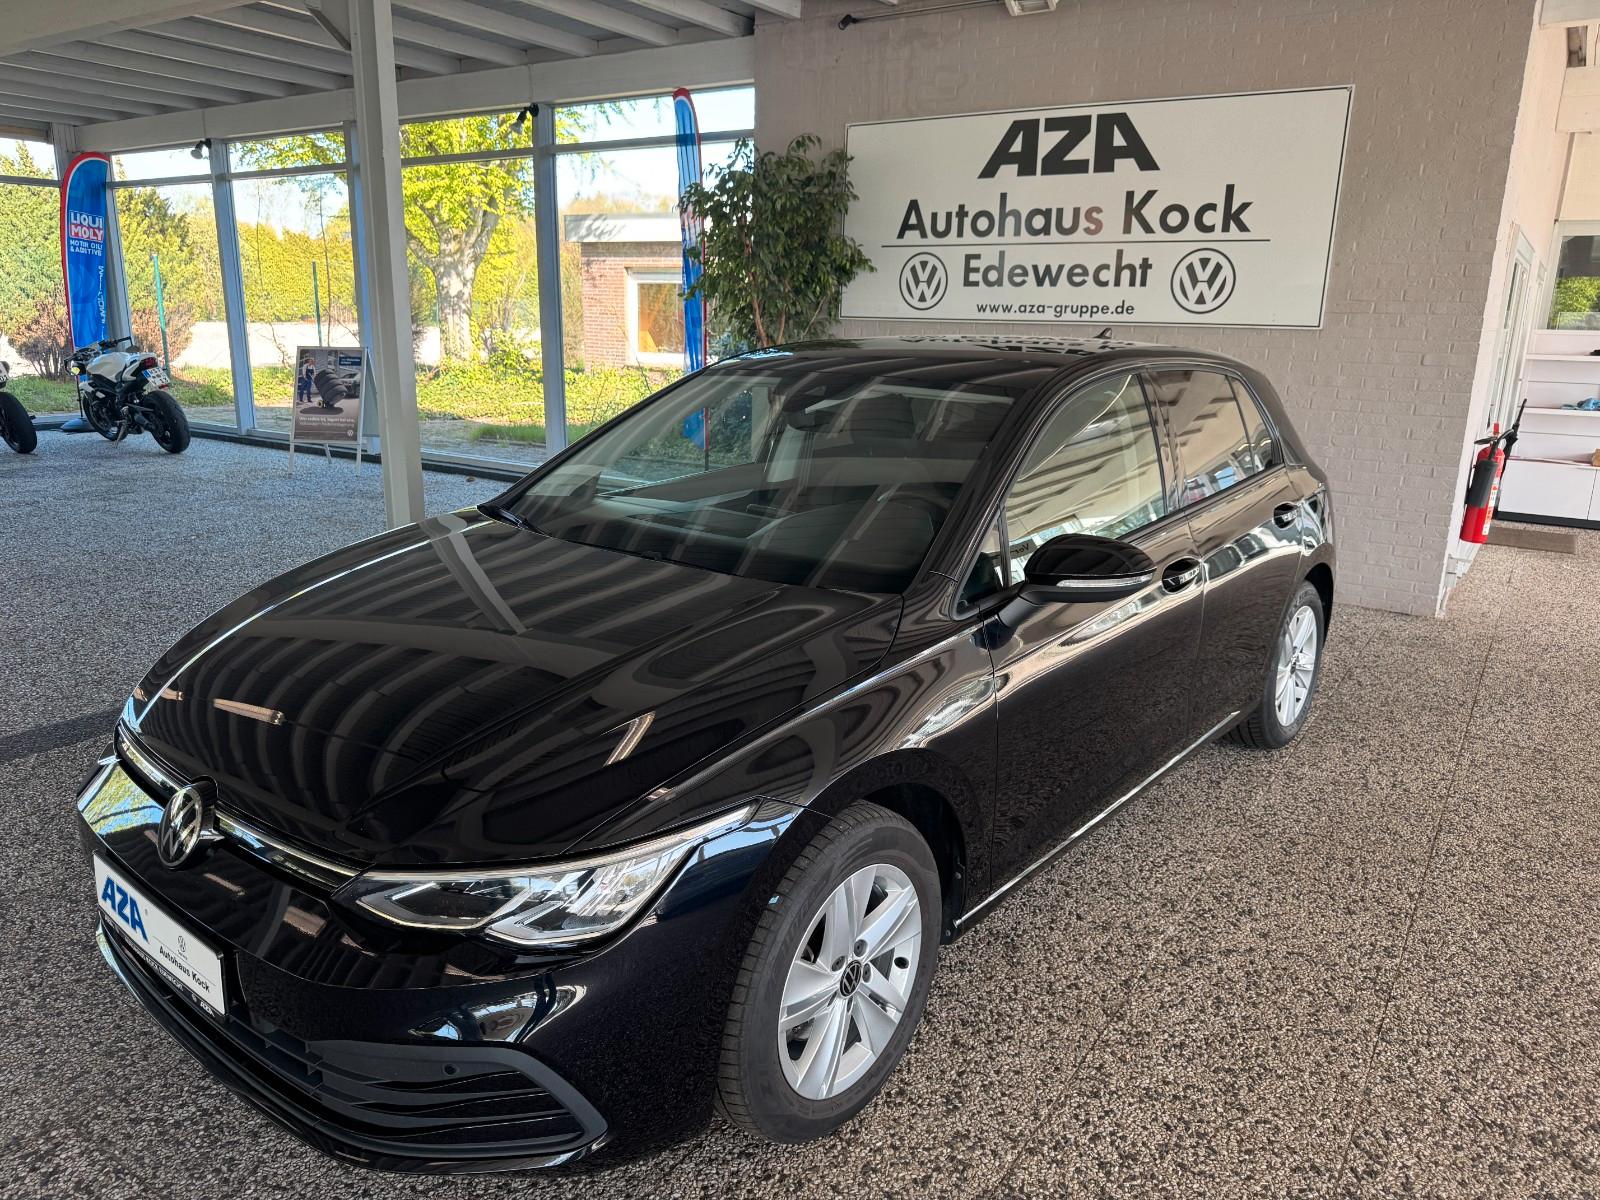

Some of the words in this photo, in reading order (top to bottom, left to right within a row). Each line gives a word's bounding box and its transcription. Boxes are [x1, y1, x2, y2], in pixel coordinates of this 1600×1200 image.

[977, 112, 1160, 179] AZA
[71, 212, 103, 229] LIQUI
[71, 224, 104, 241] MOLY
[897, 192, 1102, 239] Autohaus
[1123, 184, 1252, 234] Kock
[963, 249, 1152, 287] Edewecht
[977, 300, 1134, 317] www.aza-gruppe.de
[101, 876, 149, 943] AZA
[159, 945, 191, 977] Autohaus
[192, 970, 211, 993] Kock
